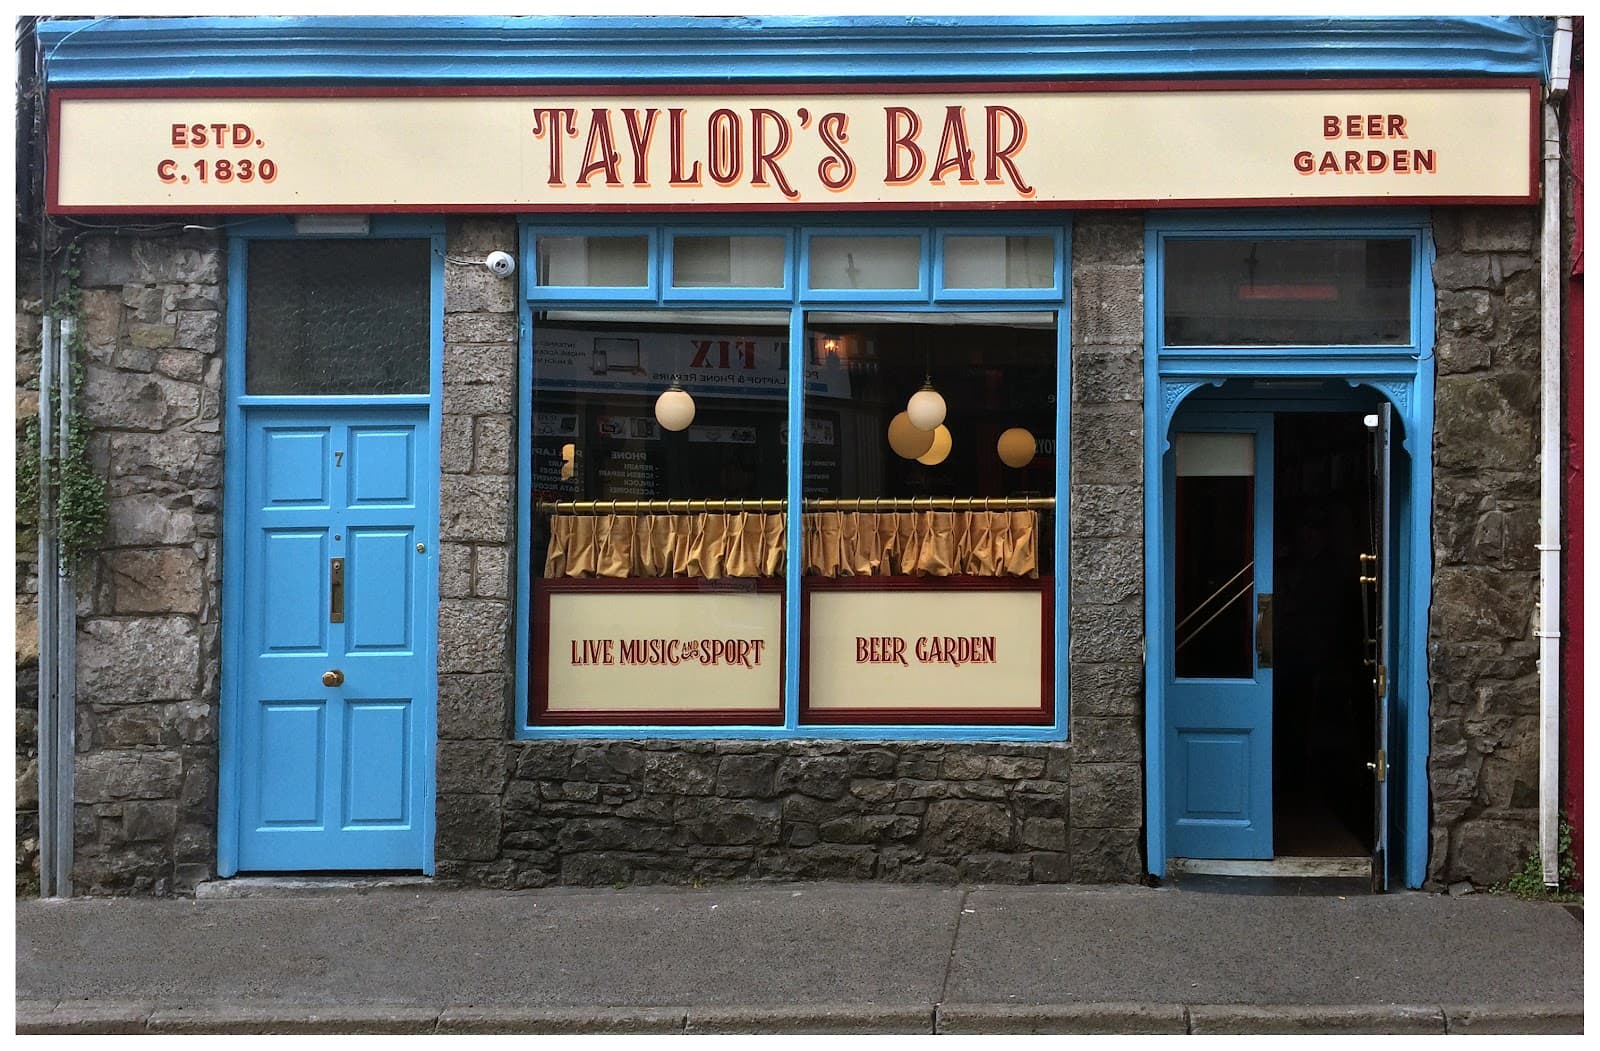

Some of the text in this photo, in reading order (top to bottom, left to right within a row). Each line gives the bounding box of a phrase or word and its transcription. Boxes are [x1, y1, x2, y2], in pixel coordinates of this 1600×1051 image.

[171, 123, 265, 149] ESTD.
[1323, 114, 1408, 140] BEER
[532, 105, 1036, 200] TAYLOR'S BAR
[1293, 149, 1437, 176] GARDEN
[335, 451, 344, 468] 7
[570, 639, 614, 666] LIVE
[619, 639, 681, 666] MUSIC
[699, 639, 765, 669] SPORT
[855, 636, 997, 667] BEER GARDEN
